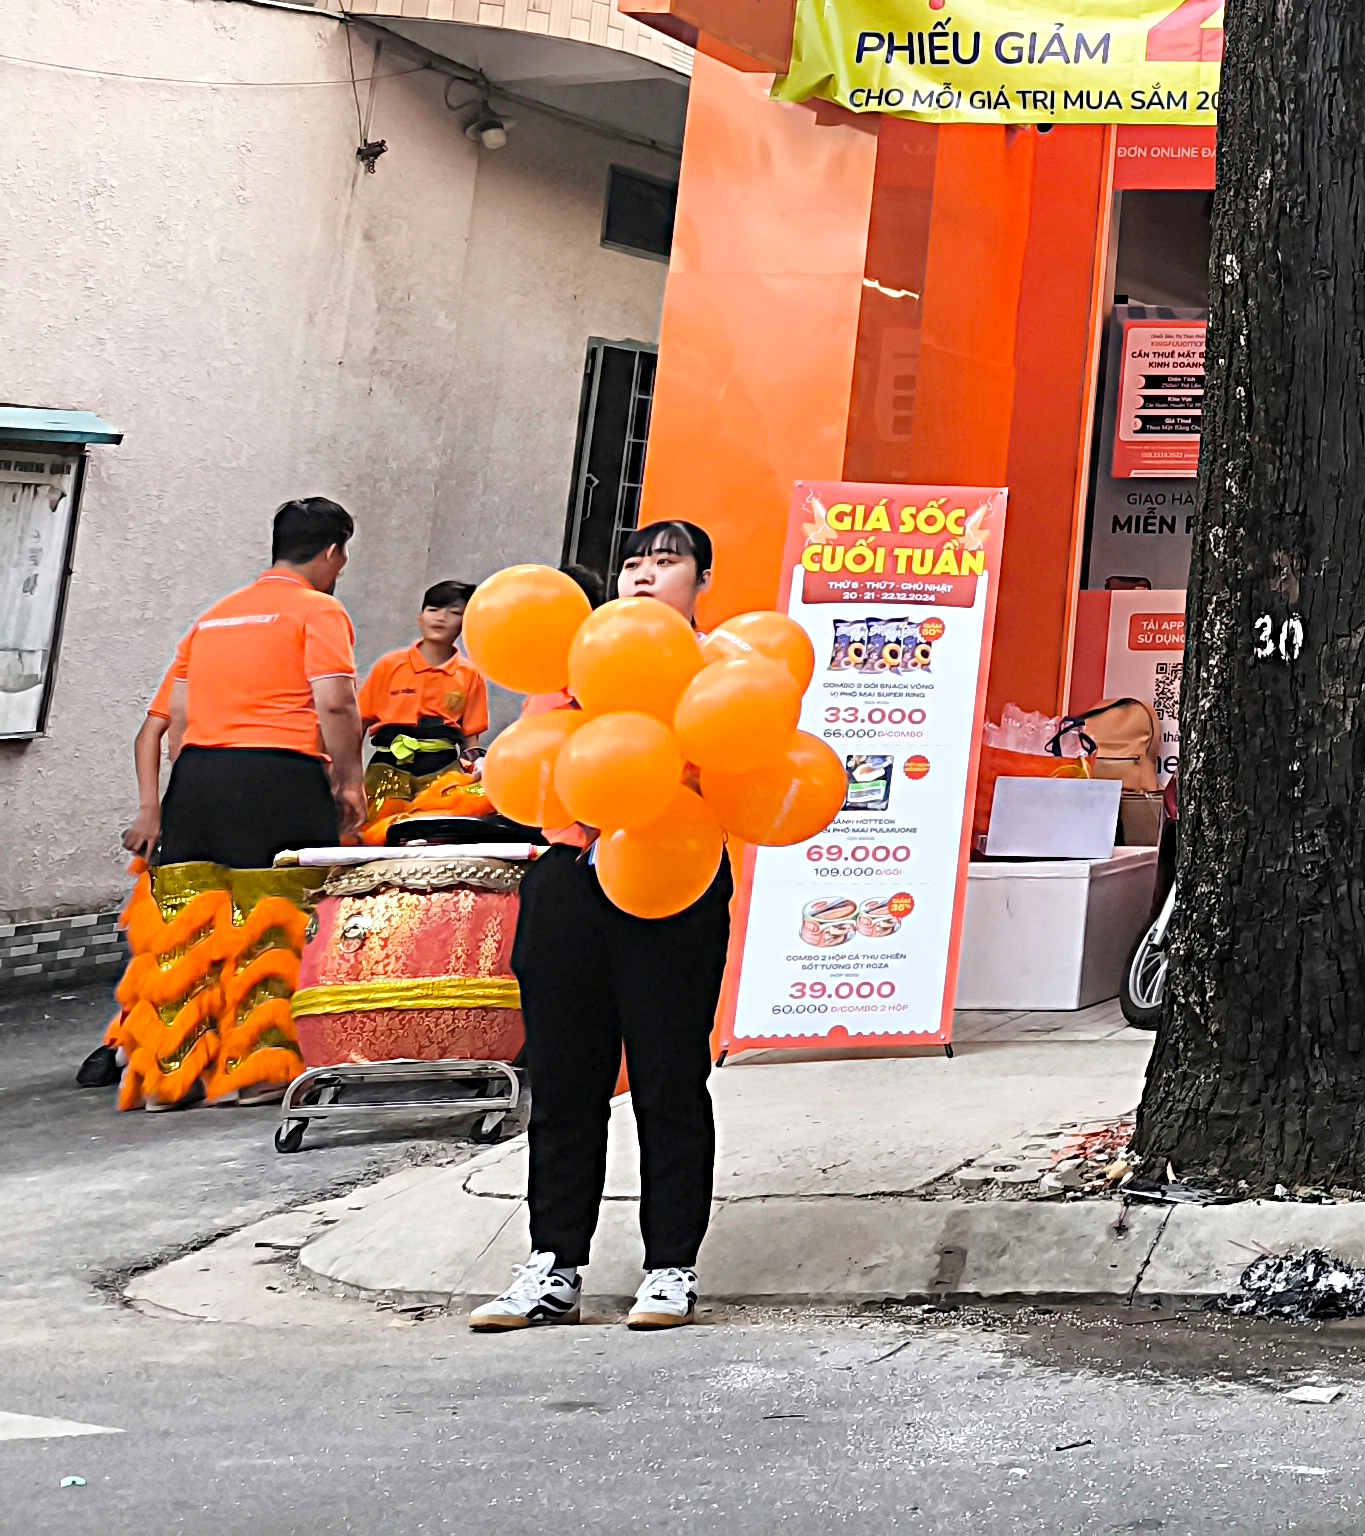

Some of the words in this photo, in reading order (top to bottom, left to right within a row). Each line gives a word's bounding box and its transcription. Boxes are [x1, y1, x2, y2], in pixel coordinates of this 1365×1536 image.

[855, 17, 981, 64] PHIẾU
[994, 22, 1111, 64] GIẢM
[849, 87, 904, 108] CHO
[911, 81, 961, 109] MỖI
[969, 85, 1010, 110] GIÁ
[1016, 89, 1055, 114] TRỊ
[1063, 89, 1123, 110] MUA
[1130, 84, 1187, 110] SẮM
[1117, 143, 1147, 159] ĐƠN
[1150, 146, 1199, 159] ONLINE
[1152, 349, 1175, 359] THUÊ
[1148, 361, 1170, 369] KINH
[1126, 493, 1166, 506] GIAO
[825, 497, 892, 532] GIÁ
[899, 497, 966, 535] SỐC
[1111, 506, 1177, 534] MIỄN
[801, 536, 886, 574] CUỐI
[893, 538, 986, 576] TUẦN
[925, 582, 953, 596] NHẬT
[842, 592, 858, 600] 20
[864, 592, 876, 600] 21
[881, 592, 936, 602] 22.12.2024
[1141, 618, 1158, 630] TẢI
[1161, 620, 1184, 630] APP
[1137, 631, 1152, 644] SỬ
[1253, 614, 1304, 661] 30
[824, 706, 926, 725] 33.000
[823, 728, 877, 739] 66.000
[806, 844, 911, 863] 69.000
[813, 867, 874, 877] 109.000
[789, 980, 896, 1000] 39.000
[772, 1004, 828, 1015] 60.000
